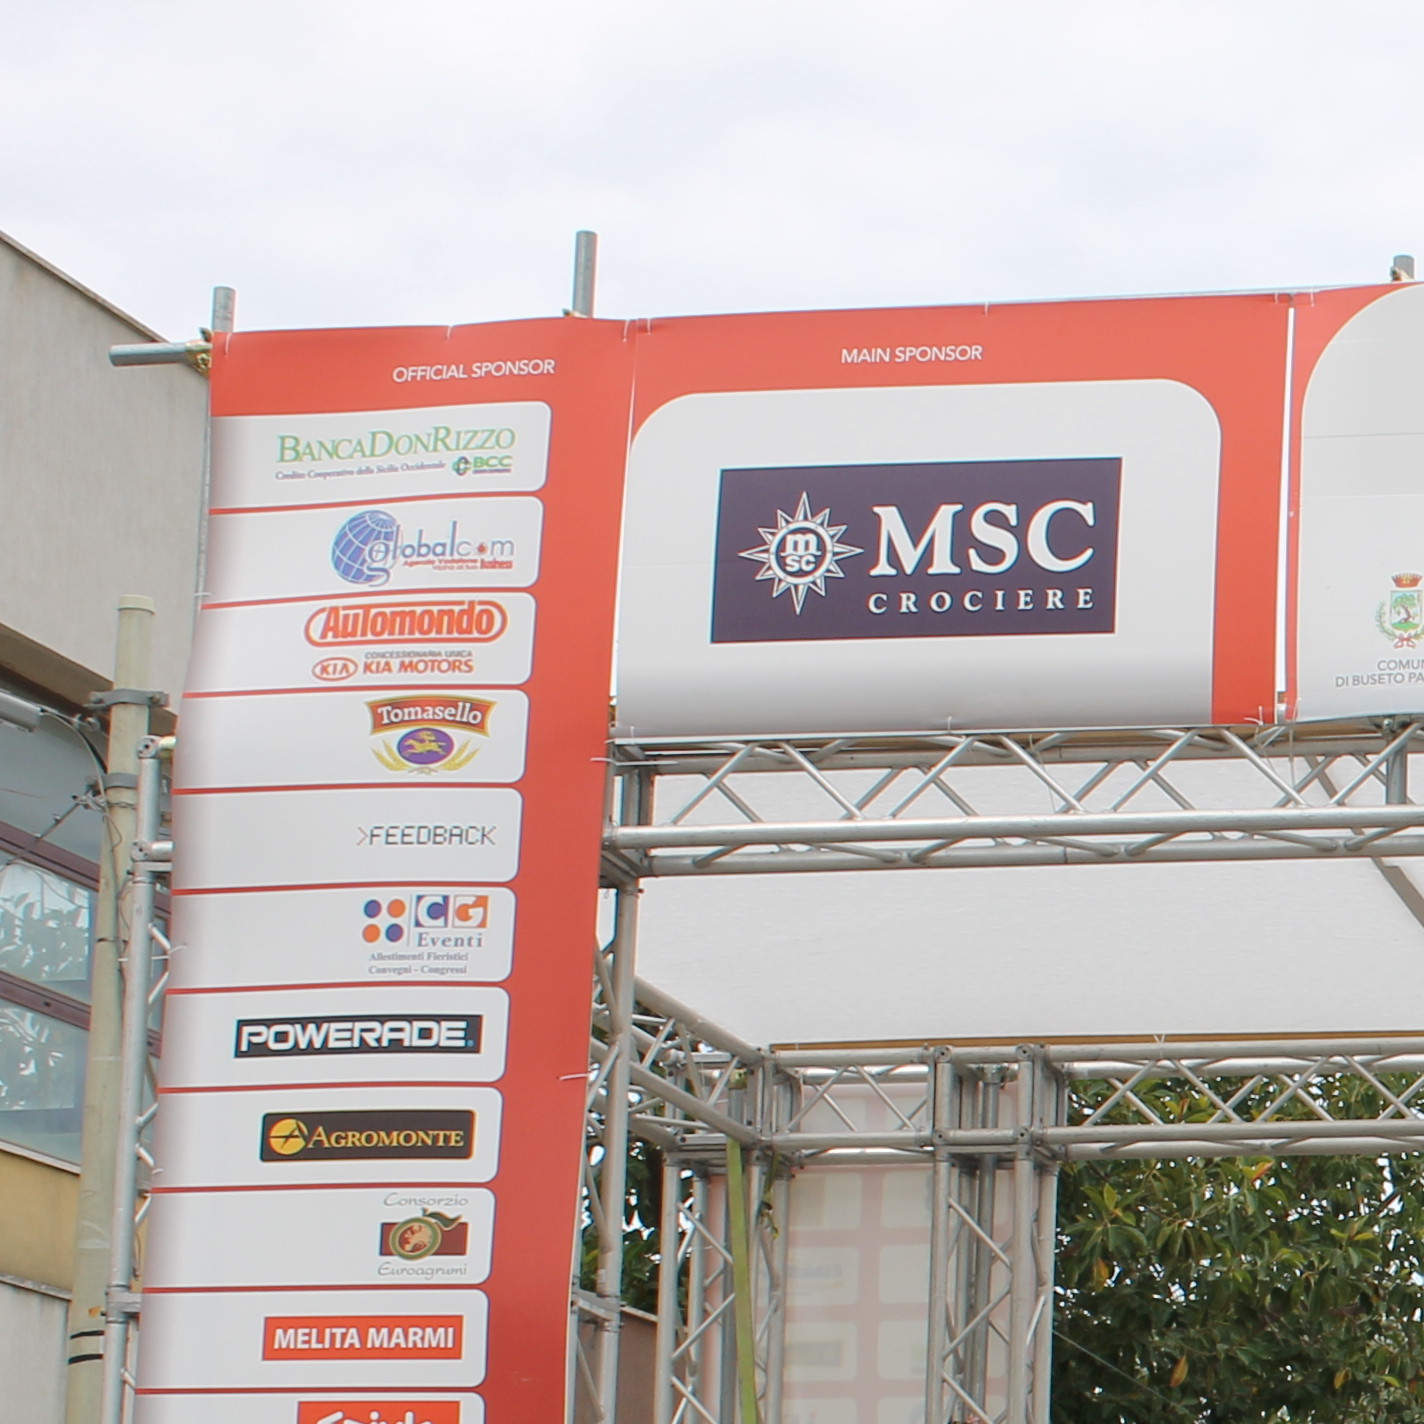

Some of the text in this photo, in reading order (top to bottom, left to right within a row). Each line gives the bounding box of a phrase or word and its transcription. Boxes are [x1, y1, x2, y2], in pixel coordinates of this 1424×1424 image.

[841, 345, 983, 363] MAIN SPONSOR
[392, 359, 556, 383] OFFICIAL SPONSOR
[472, 455, 513, 468] BCC
[869, 500, 1097, 578] MSC
[869, 587, 1095, 615] CROCIERE
[320, 663, 350, 676] KIA
[362, 659, 475, 675] KIA MOTORS
[1335, 675, 1349, 688] DI
[1352, 672, 1405, 687] BUSETO
[377, 701, 483, 725] Tomasello
[416, 931, 484, 949] Eventi
[240, 1020, 469, 1052] POWERADE
[383, 1192, 469, 1208] Consorzio
[377, 1262, 468, 1280] Euroagrumi
[273, 1326, 455, 1351] MELITA MARMI
